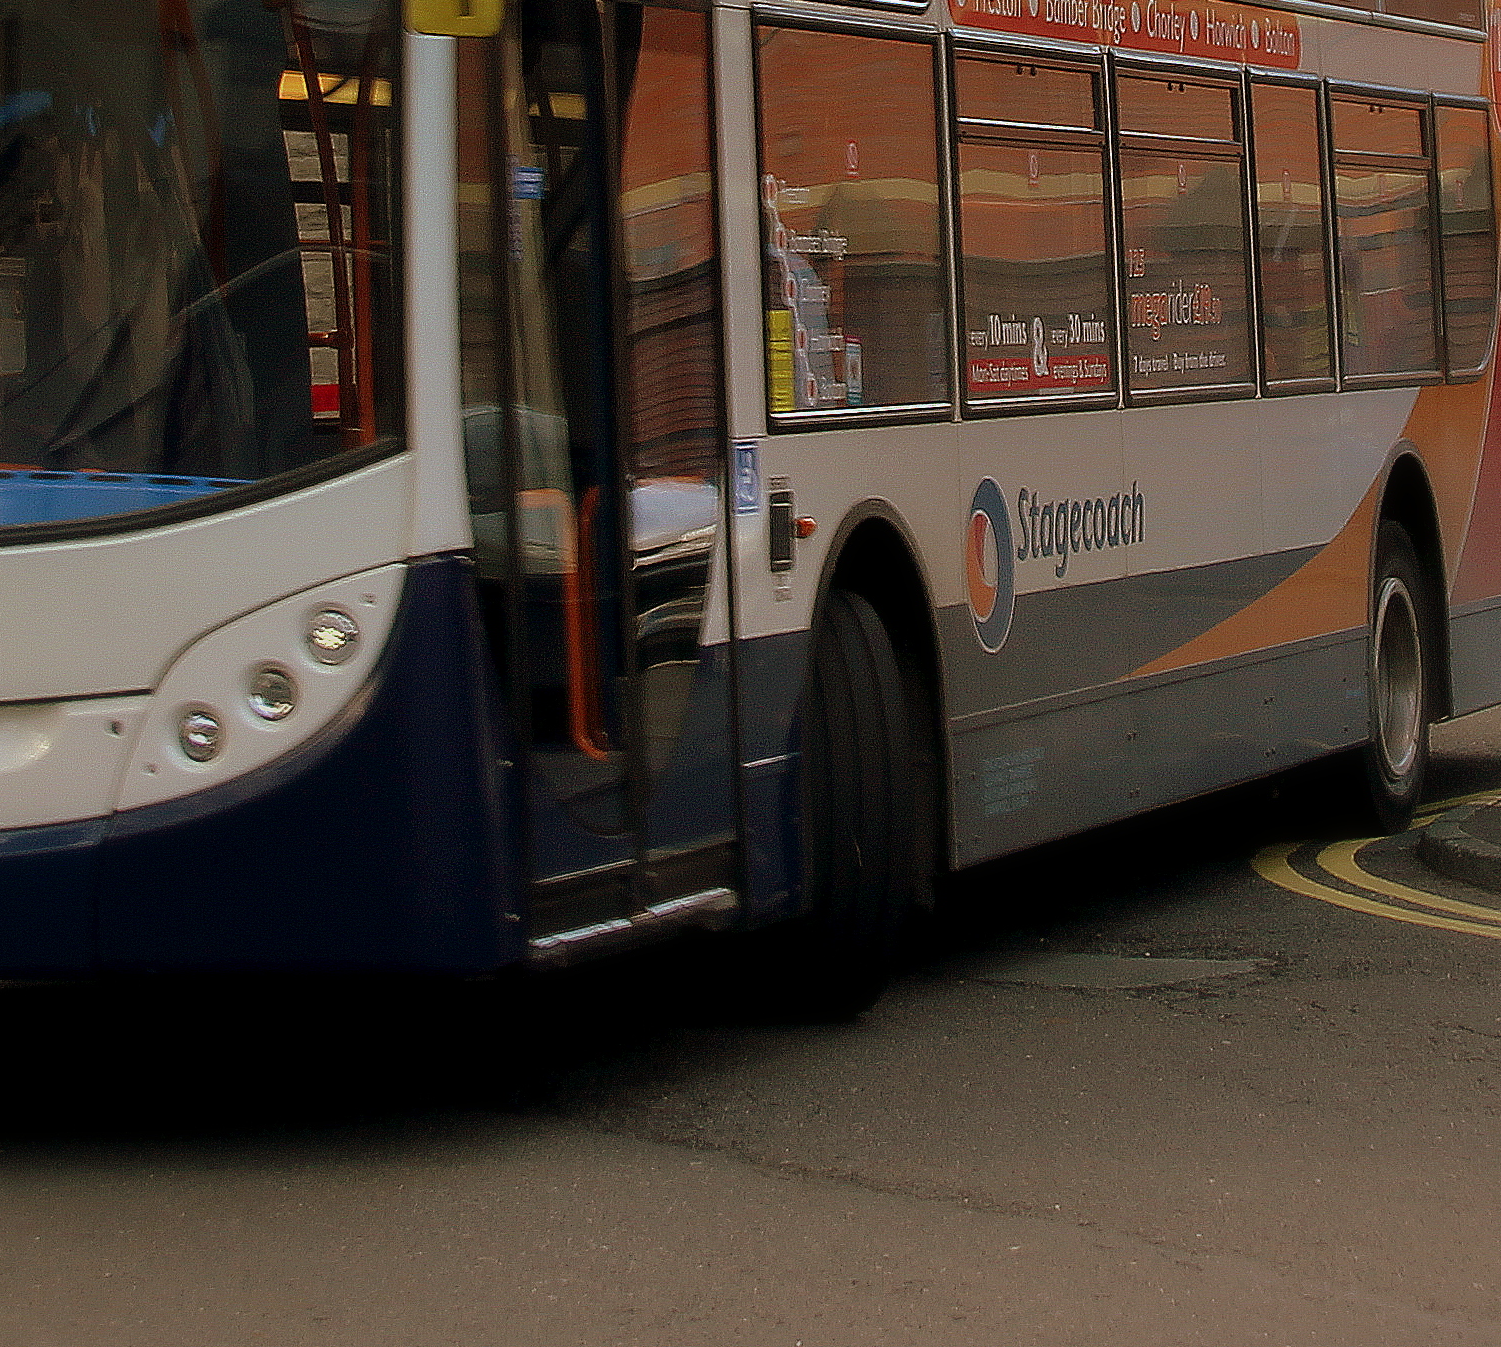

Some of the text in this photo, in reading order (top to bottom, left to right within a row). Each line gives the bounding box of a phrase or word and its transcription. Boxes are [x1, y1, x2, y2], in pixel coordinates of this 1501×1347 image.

[1146, 0, 1187, 53] Chorley
[1205, 8, 1247, 51] Horwich
[1264, 17, 1296, 57] Bolton
[989, 314, 1000, 346] 10
[1002, 313, 1028, 345] mins
[1033, 316, 1050, 377] &
[1082, 313, 1106, 343] mins
[1017, 479, 1147, 579] Stagecoach
